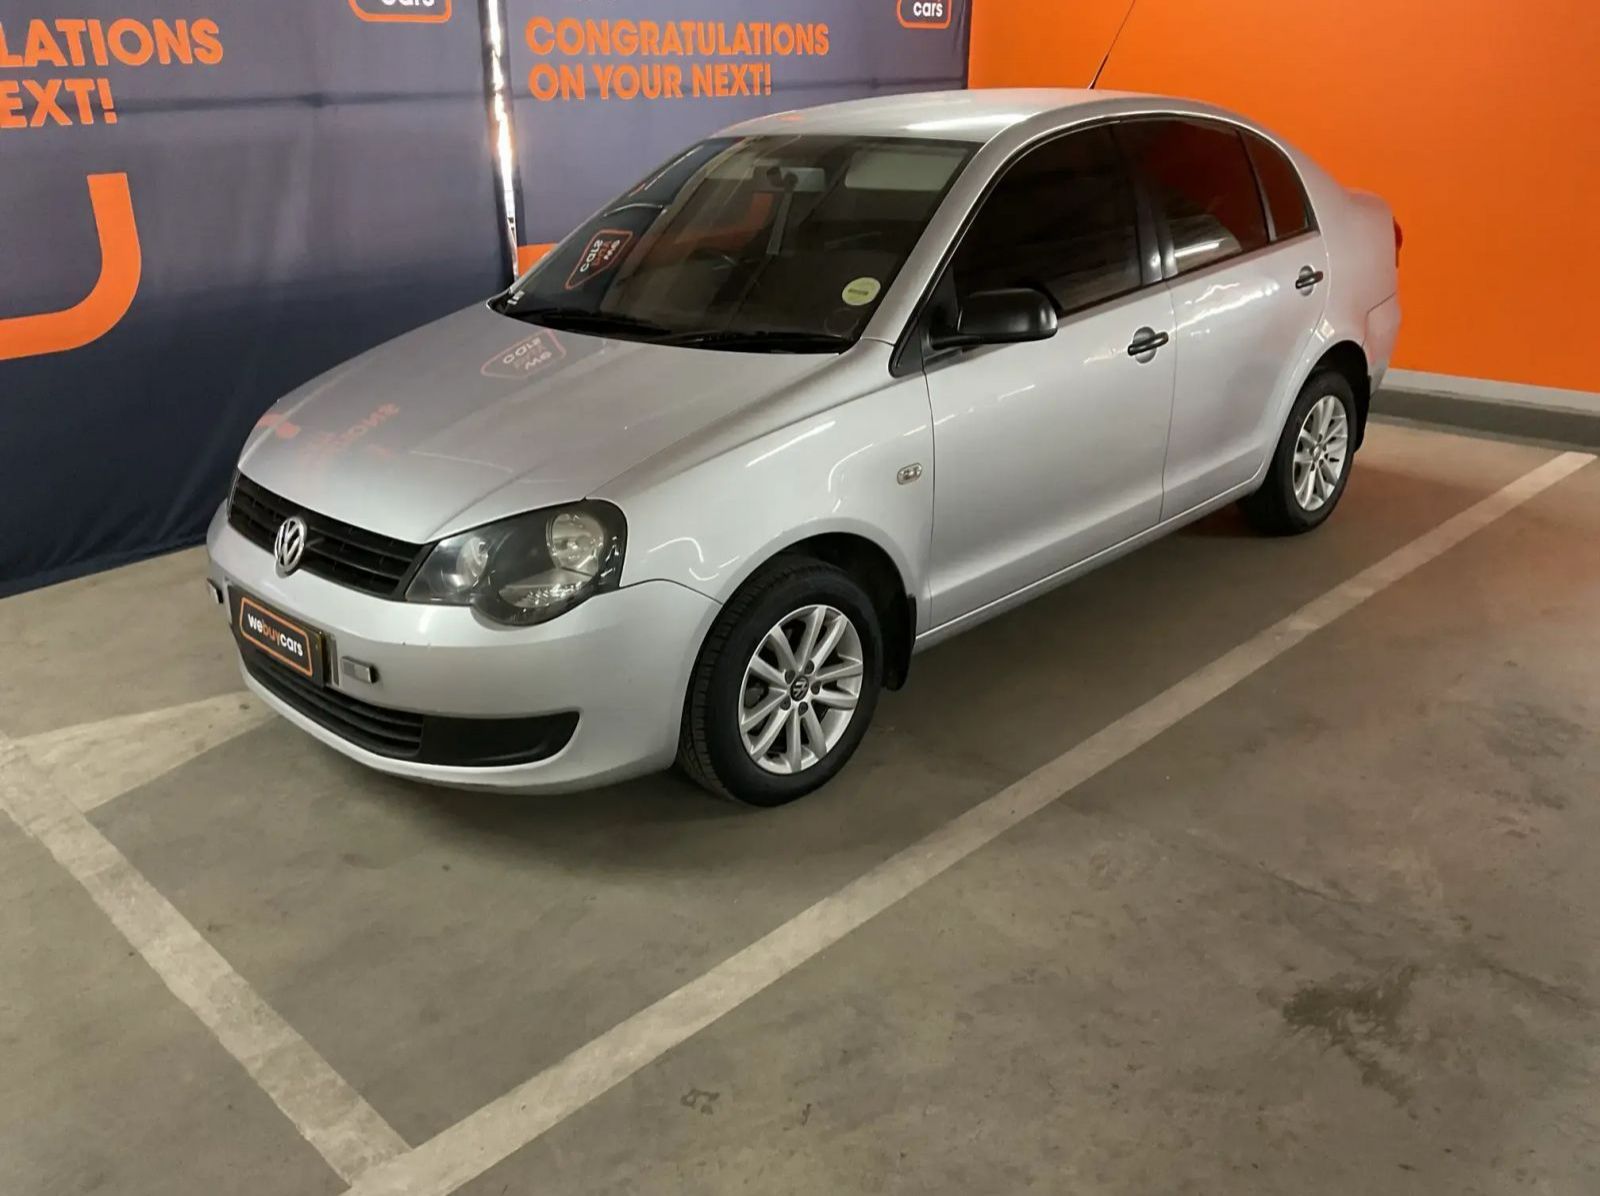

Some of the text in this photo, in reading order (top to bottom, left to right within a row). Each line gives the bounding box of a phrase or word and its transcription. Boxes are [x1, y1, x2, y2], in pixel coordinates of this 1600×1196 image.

[913, 1, 943, 17] cars
[524, 16, 830, 56] CONGRATULATIONS
[528, 63, 772, 101] ON YOUR NEXT!
[0, 78, 118, 128] EXT!
[247, 613, 303, 657] webuycars
